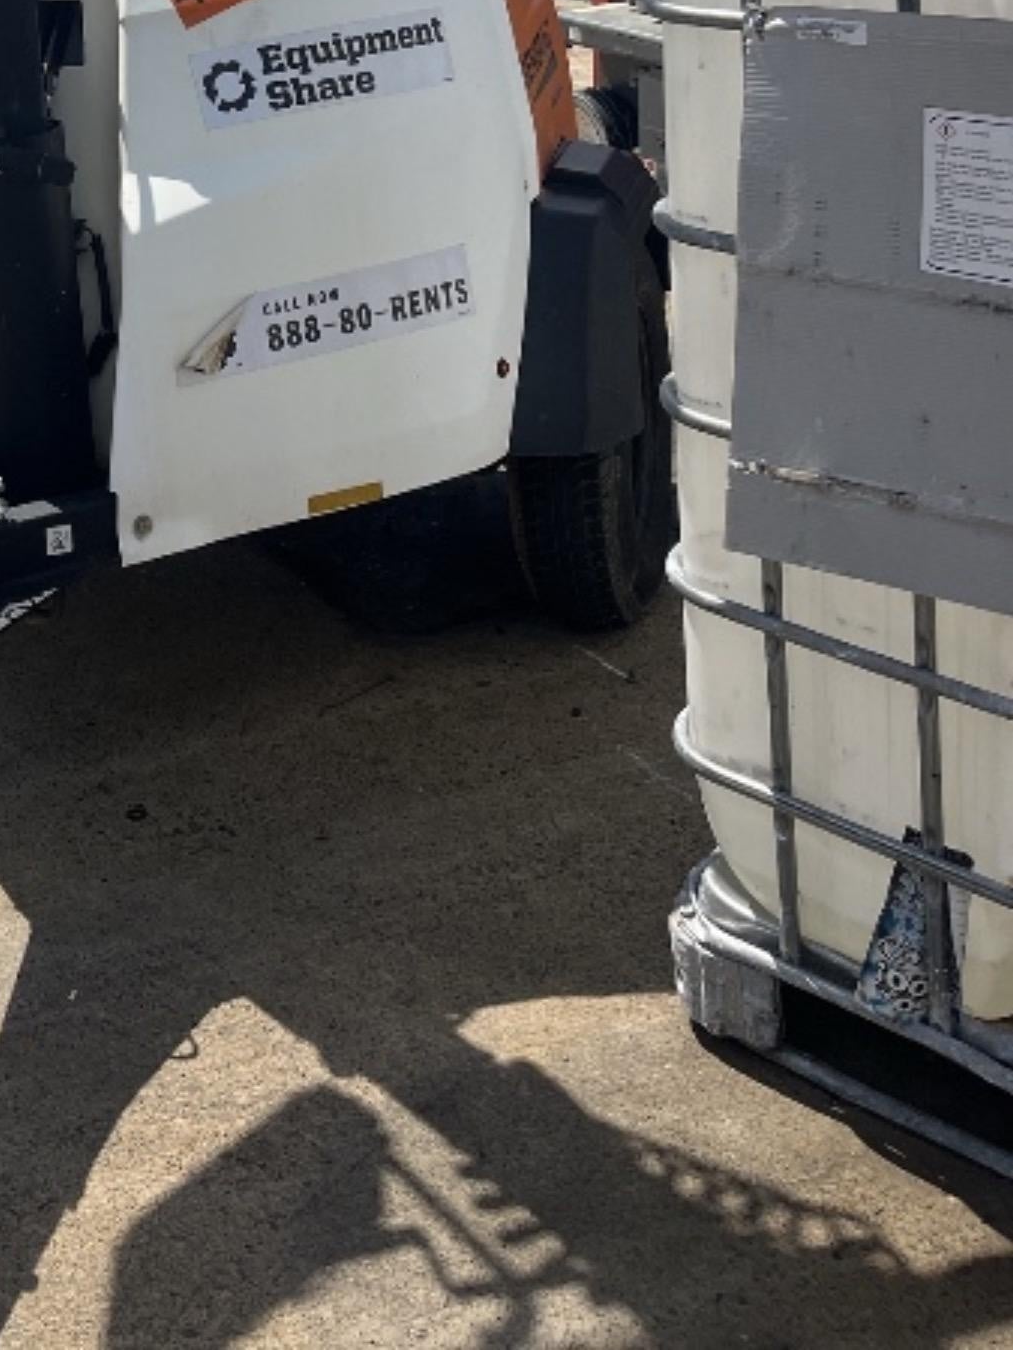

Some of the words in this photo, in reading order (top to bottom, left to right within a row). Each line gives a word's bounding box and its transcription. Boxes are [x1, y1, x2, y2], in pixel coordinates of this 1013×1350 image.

[257, 17, 444, 76] Equipment
[265, 70, 376, 111] Share
[261, 296, 301, 316] CALL
[265, 277, 469, 352] 888-80-RENTS
